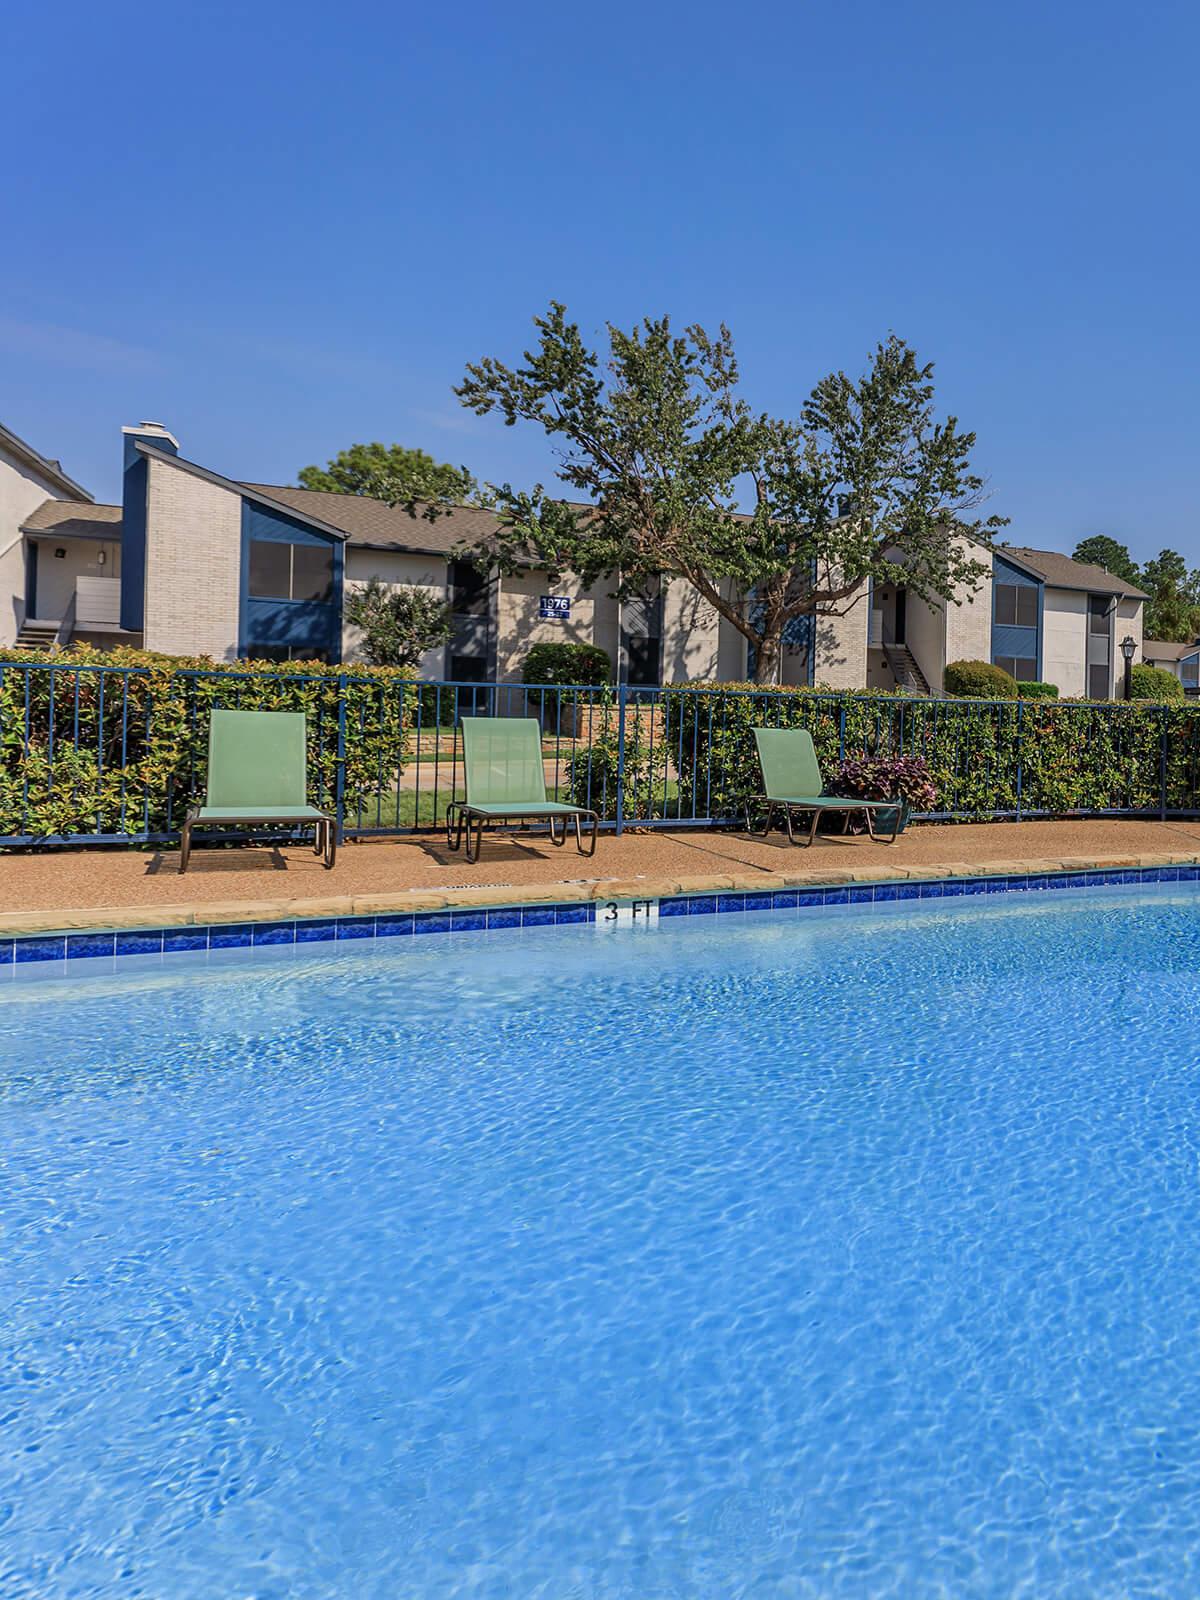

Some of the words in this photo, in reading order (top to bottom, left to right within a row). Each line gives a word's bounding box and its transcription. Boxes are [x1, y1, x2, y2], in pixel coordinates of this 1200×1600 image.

[542, 598, 568, 609] 1976
[605, 902, 618, 920] 3
[632, 900, 653, 918] FT
